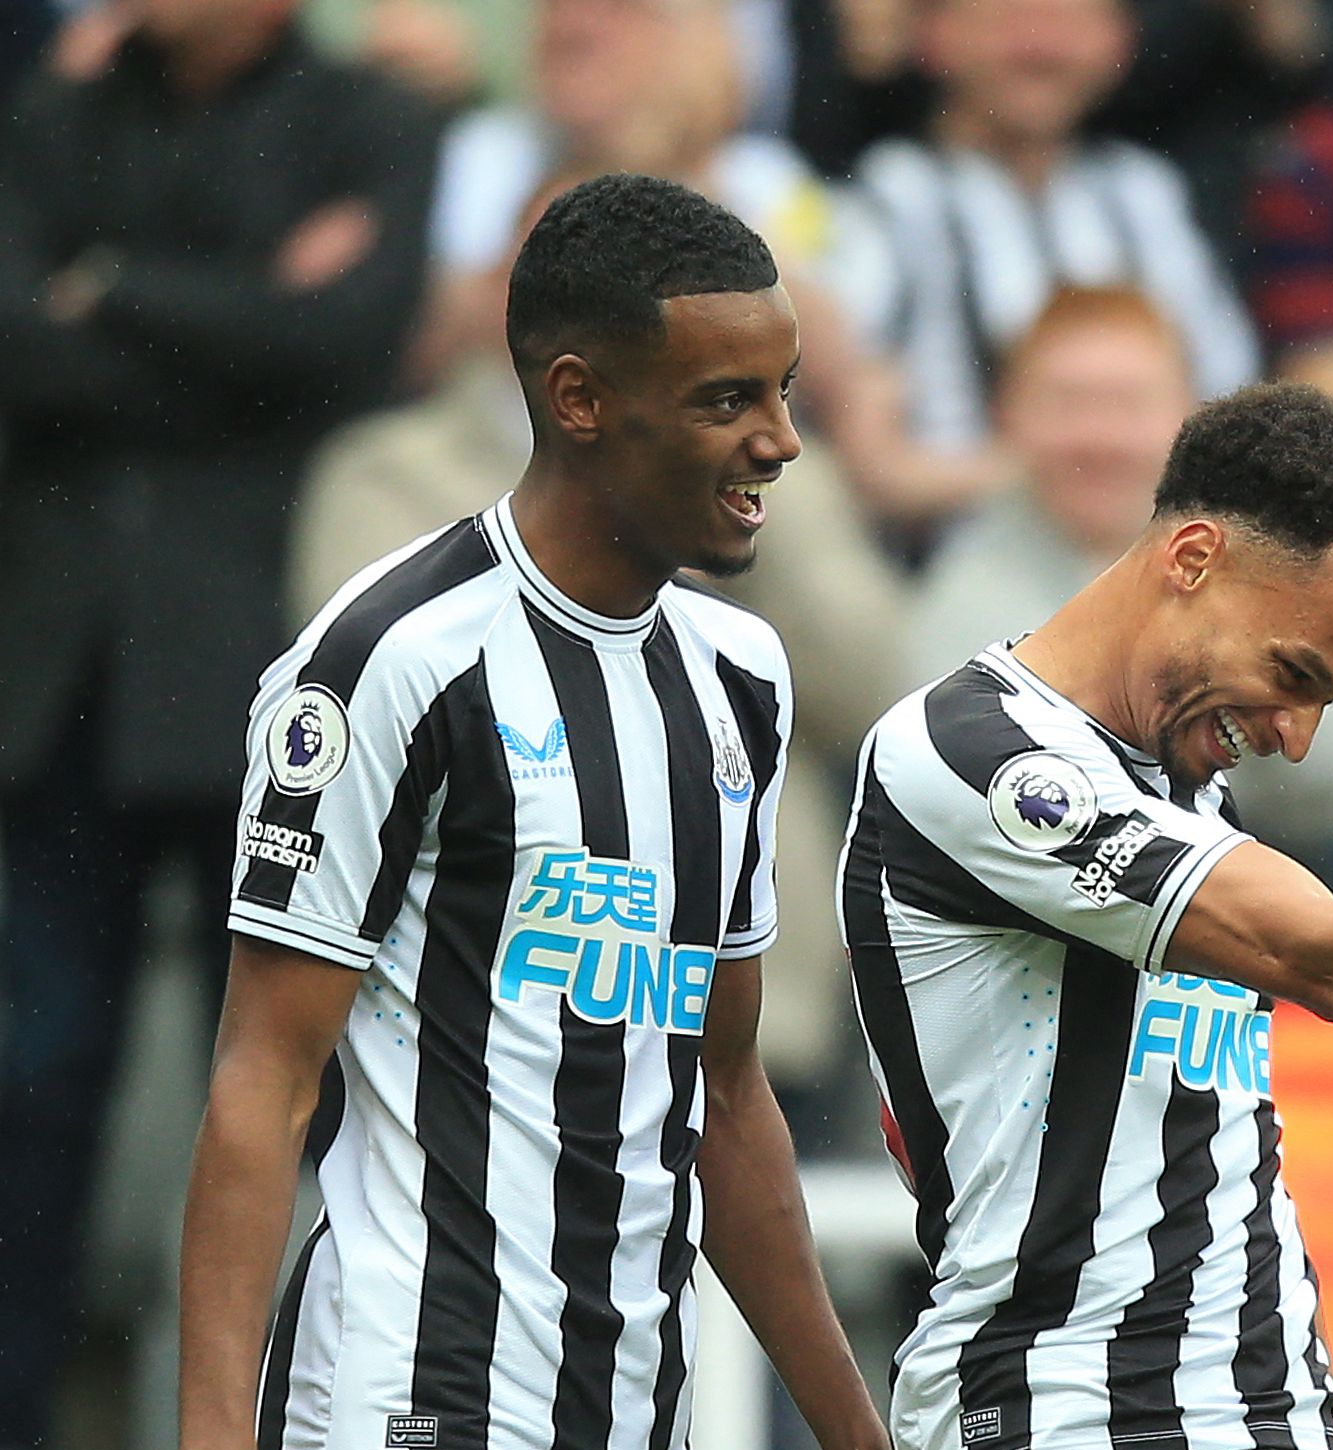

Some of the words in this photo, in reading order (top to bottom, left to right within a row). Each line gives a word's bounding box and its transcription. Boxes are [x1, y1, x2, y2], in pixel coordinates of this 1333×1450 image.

[245, 815, 263, 839] No
[263, 822, 313, 853] room
[1071, 860, 1103, 897] No
[1098, 819, 1146, 865] room
